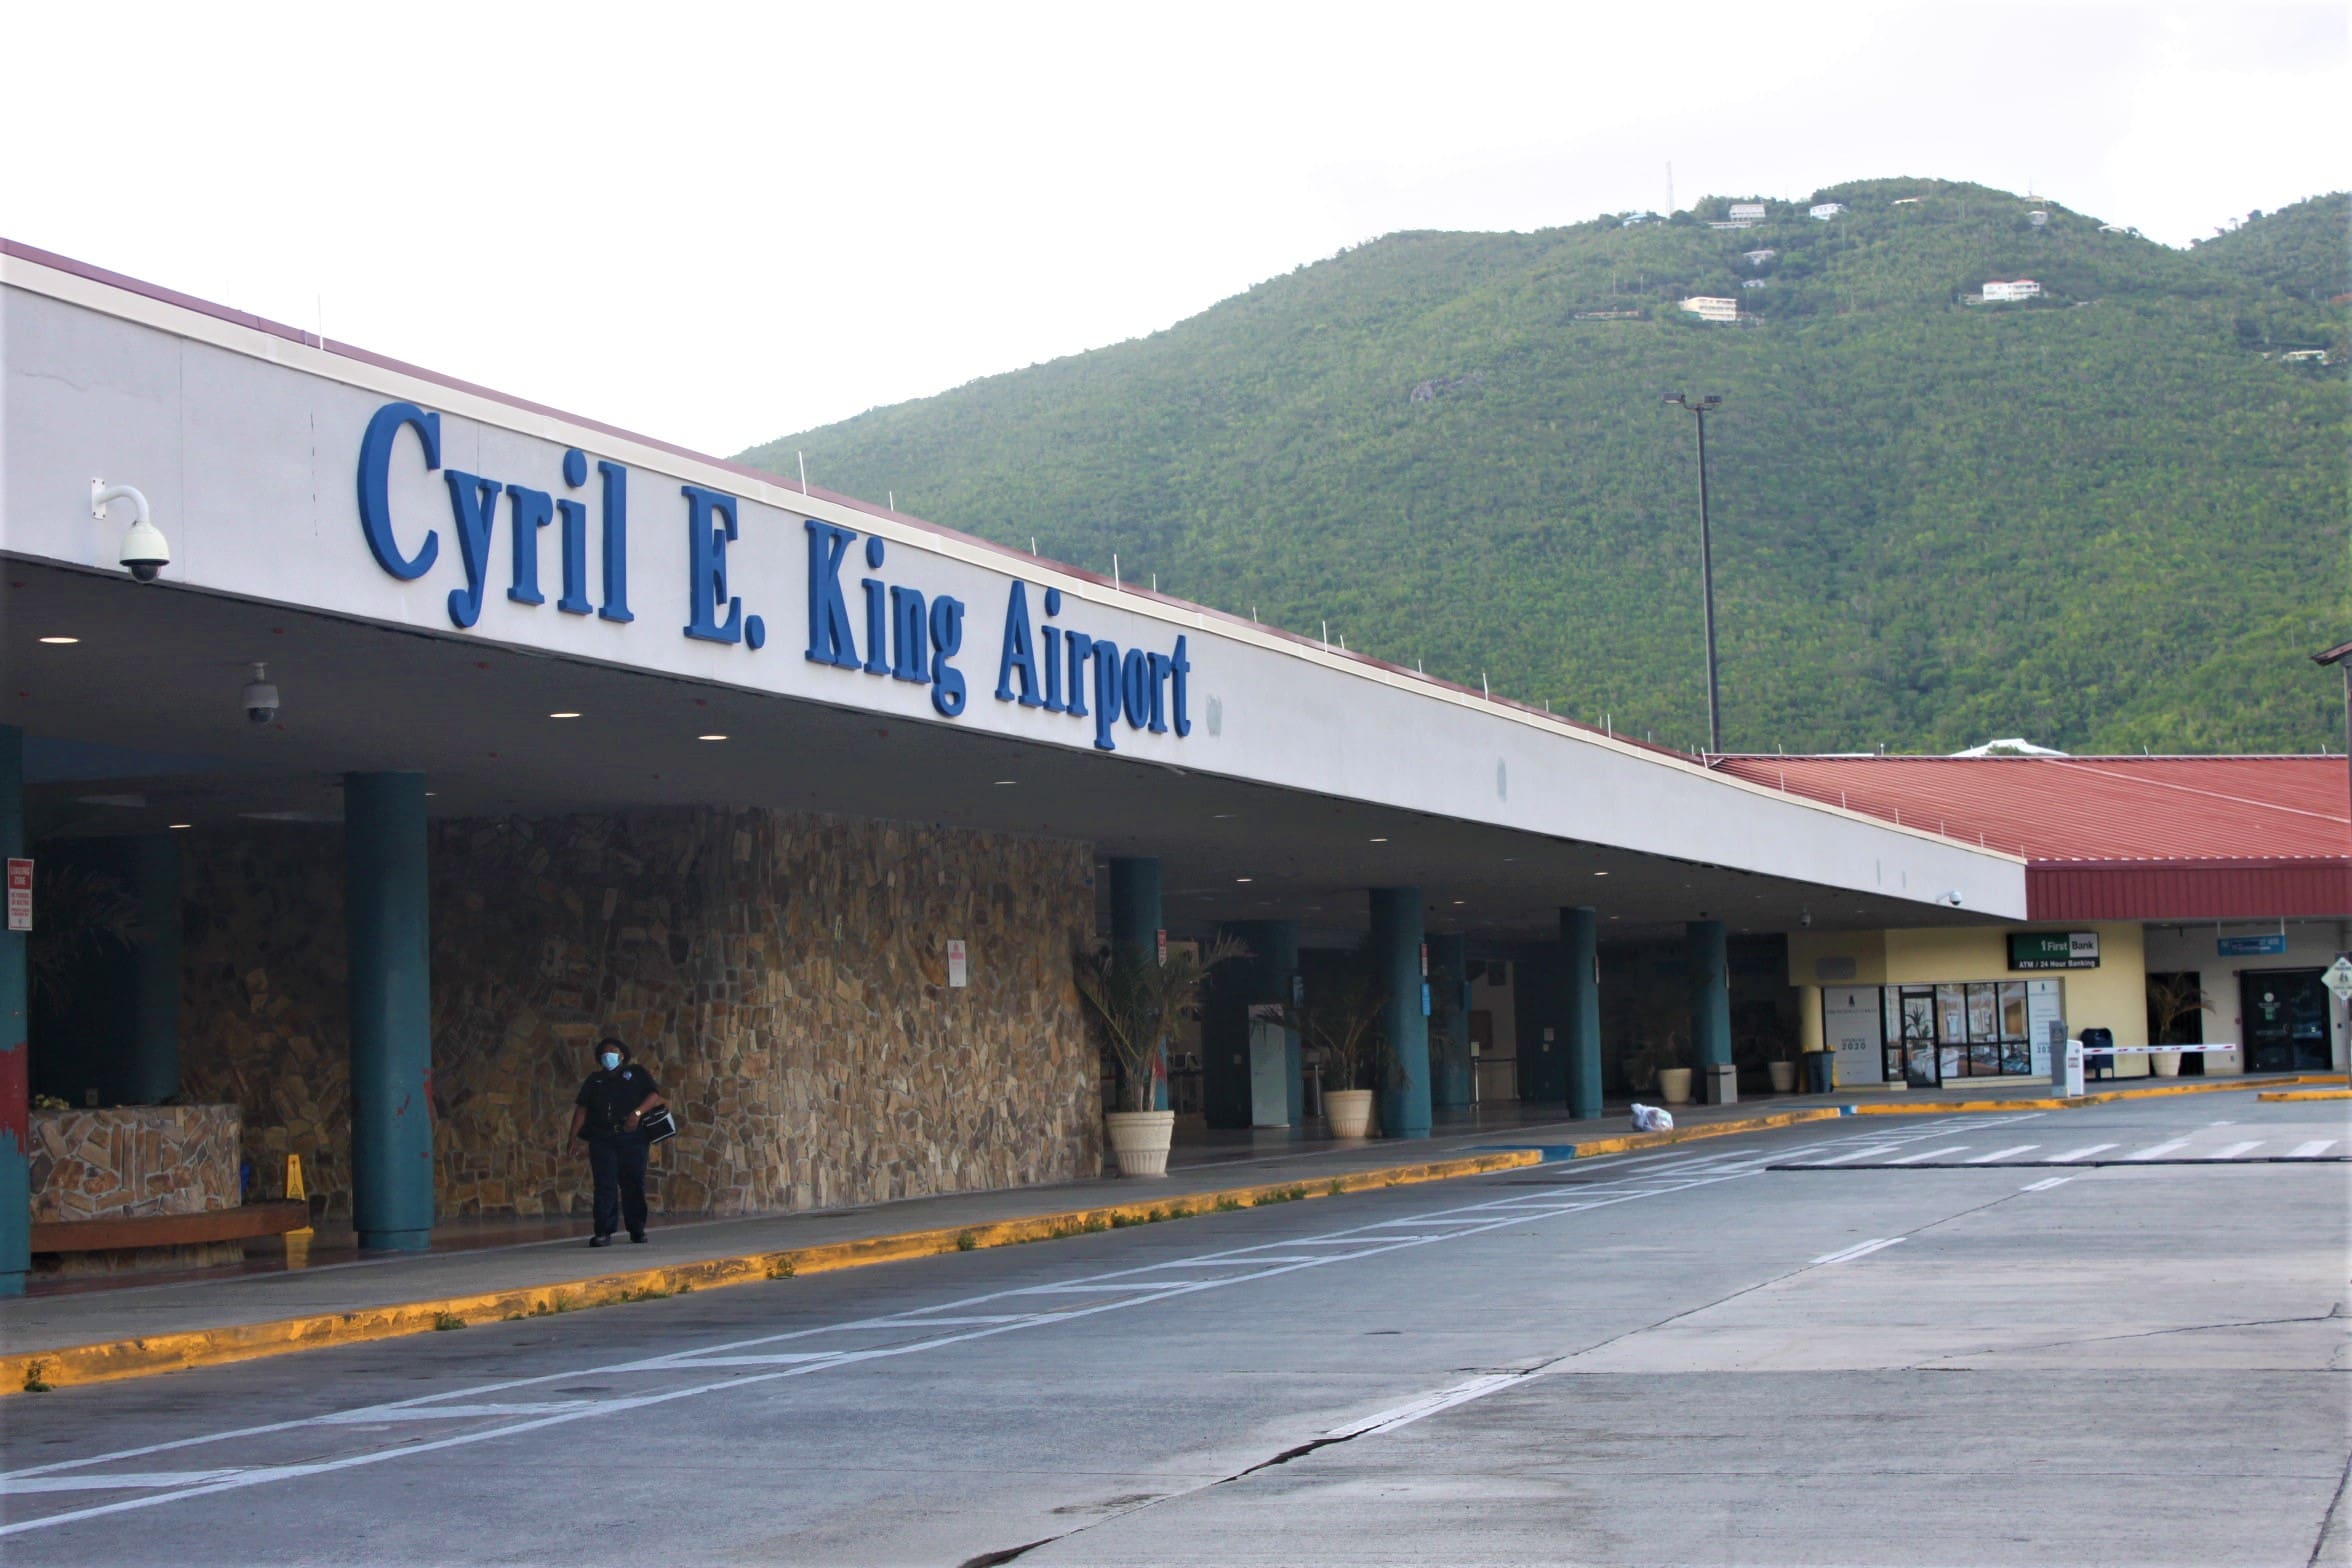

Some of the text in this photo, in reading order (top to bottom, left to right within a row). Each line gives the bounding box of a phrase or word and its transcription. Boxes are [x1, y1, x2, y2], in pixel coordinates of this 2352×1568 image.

[357, 401, 1191, 750] Cyril E. King Airport
[2071, 940, 2094, 950] Bank
[2019, 961, 2034, 969] ATM
[2040, 960, 2049, 968] 24
[2049, 960, 2067, 968] Hour
[2068, 960, 2096, 968] Banking
[1842, 1042, 1866, 1051] 2020
